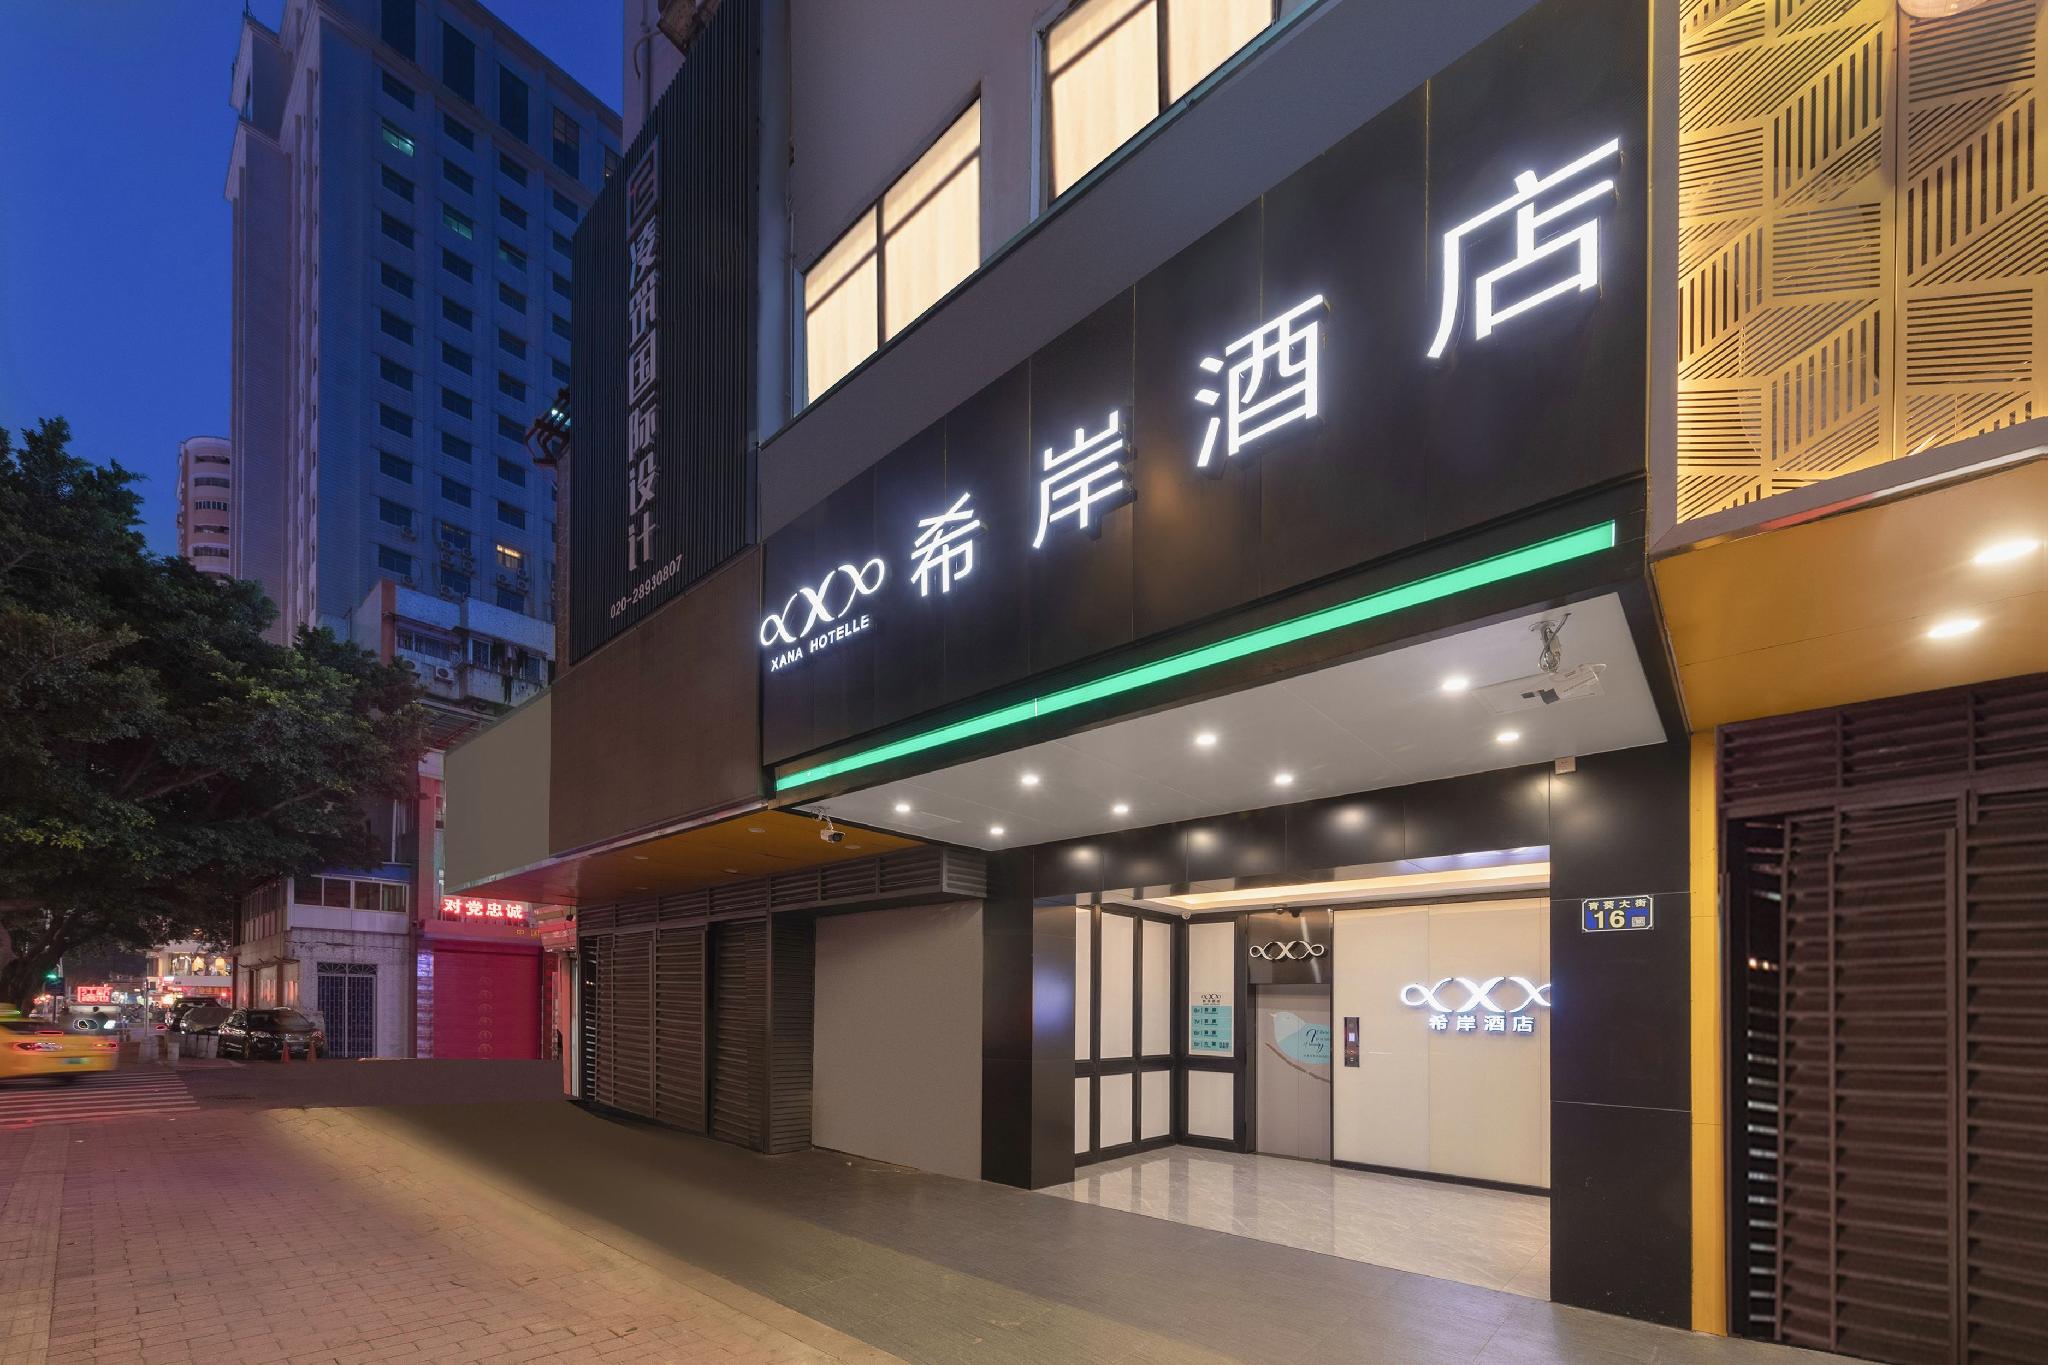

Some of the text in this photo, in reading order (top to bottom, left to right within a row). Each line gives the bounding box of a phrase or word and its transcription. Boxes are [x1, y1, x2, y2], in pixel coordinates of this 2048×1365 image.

[910, 137, 1621, 598] 希岸酒店
[610, 553, 683, 619] 020-28930807
[770, 615, 871, 672] XANA HOTELLE
[443, 898, 524, 919] 对党忠诚
[1594, 910, 1625, 929] 16
[1428, 1014, 1535, 1033] 希岸酒店
